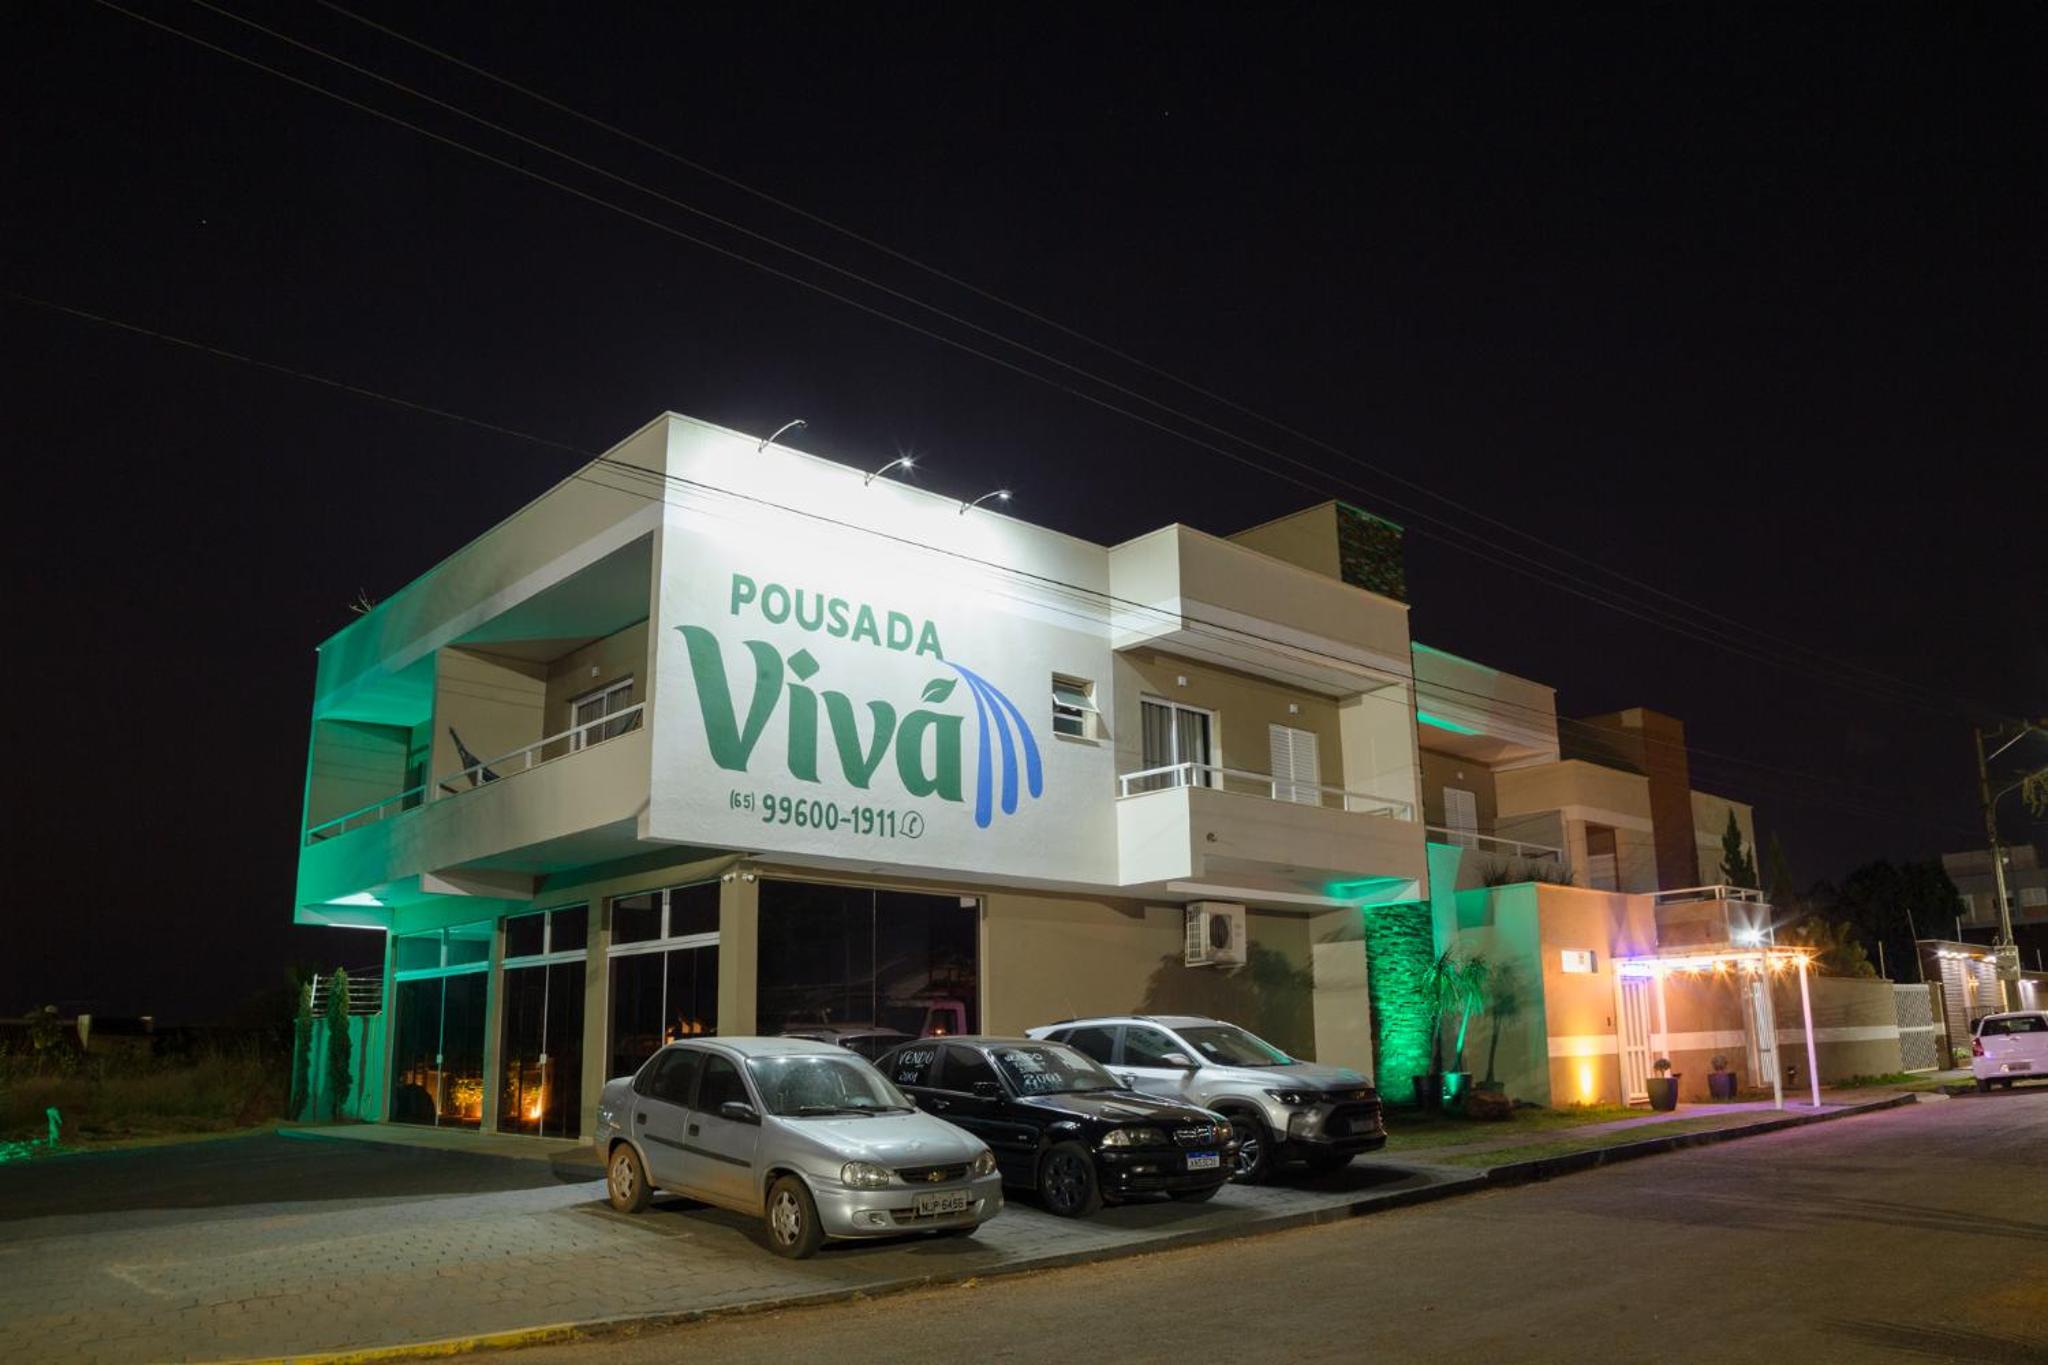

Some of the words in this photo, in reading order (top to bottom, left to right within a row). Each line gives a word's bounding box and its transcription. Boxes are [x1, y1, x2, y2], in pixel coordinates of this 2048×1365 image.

[730, 574, 944, 660] POUSADA
[674, 625, 964, 802] Vivá
[730, 789, 755, 812] (65)
[762, 794, 897, 838] 99600-1911
